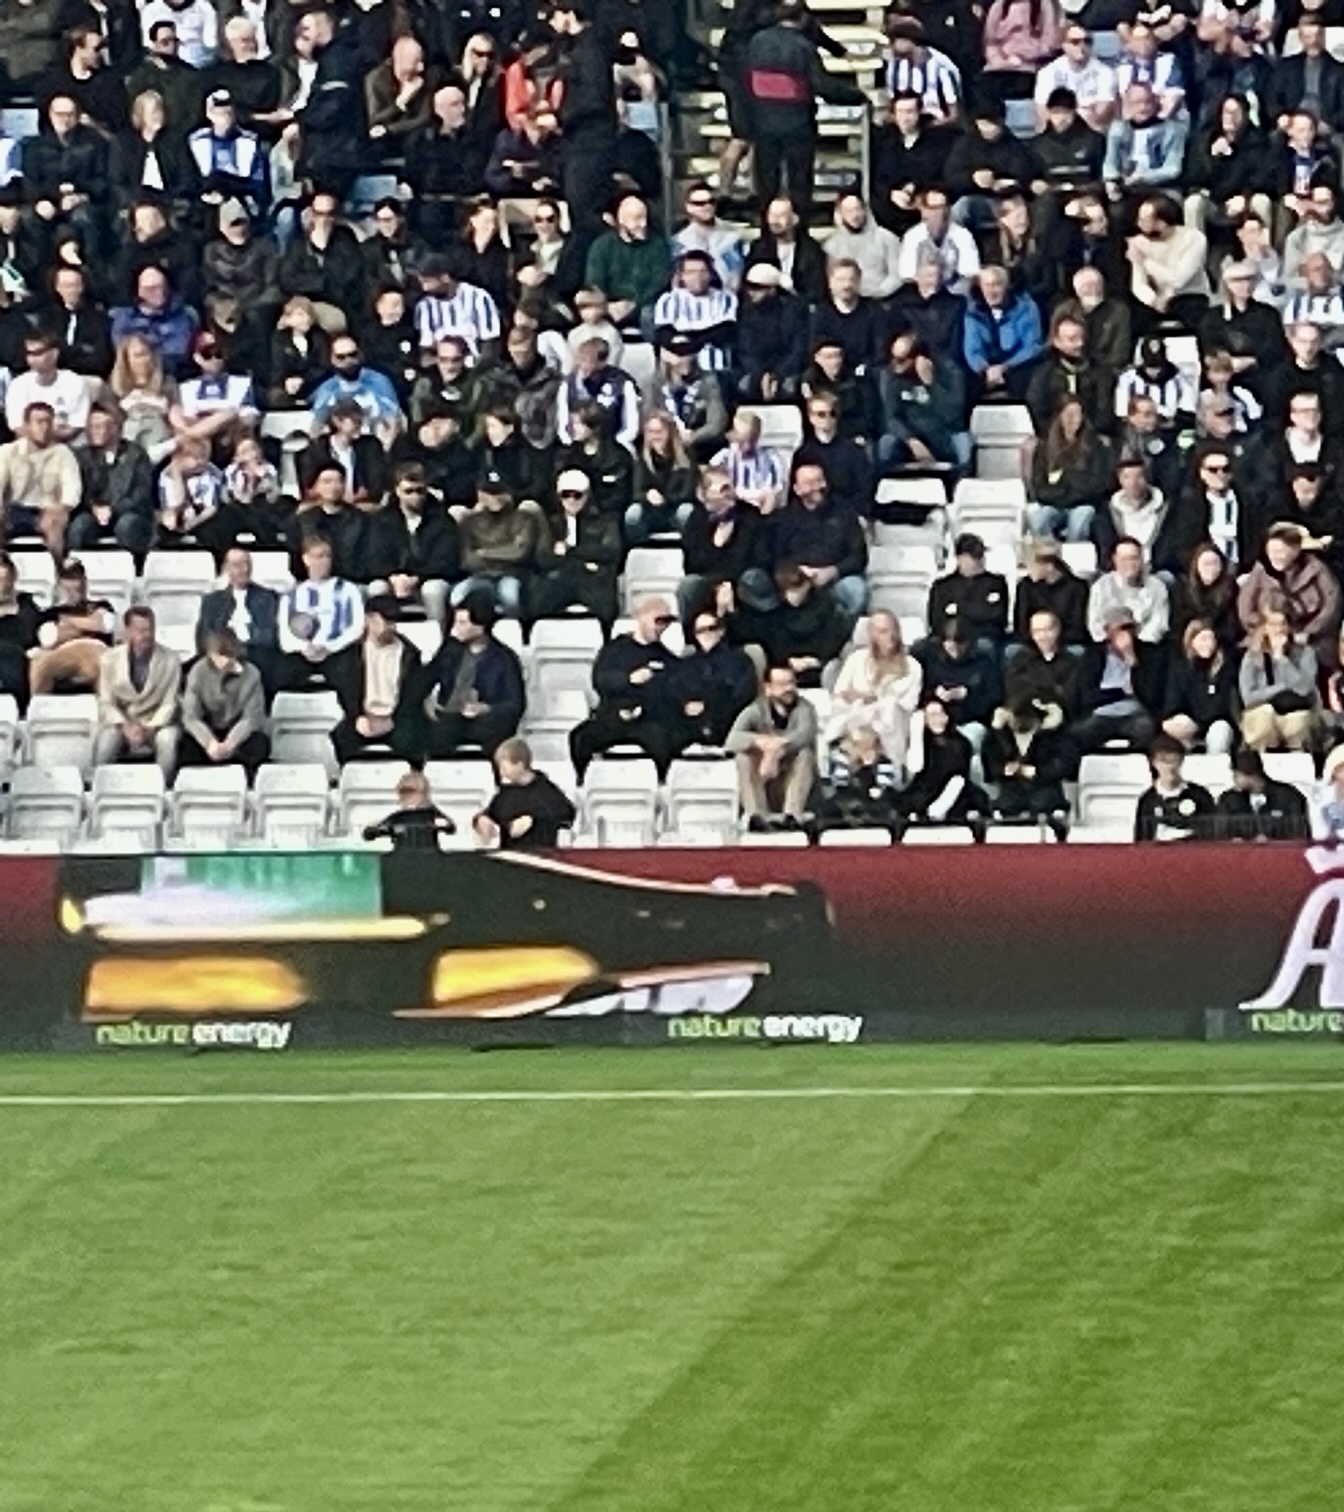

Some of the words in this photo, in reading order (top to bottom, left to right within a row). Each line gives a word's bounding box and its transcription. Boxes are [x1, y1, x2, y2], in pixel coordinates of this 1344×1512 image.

[668, 1015, 760, 1037] nature
[763, 1016, 862, 1042] energy
[1252, 1008, 1343, 1032] nature
[97, 1021, 189, 1044] nature
[193, 1022, 291, 1048] energy
